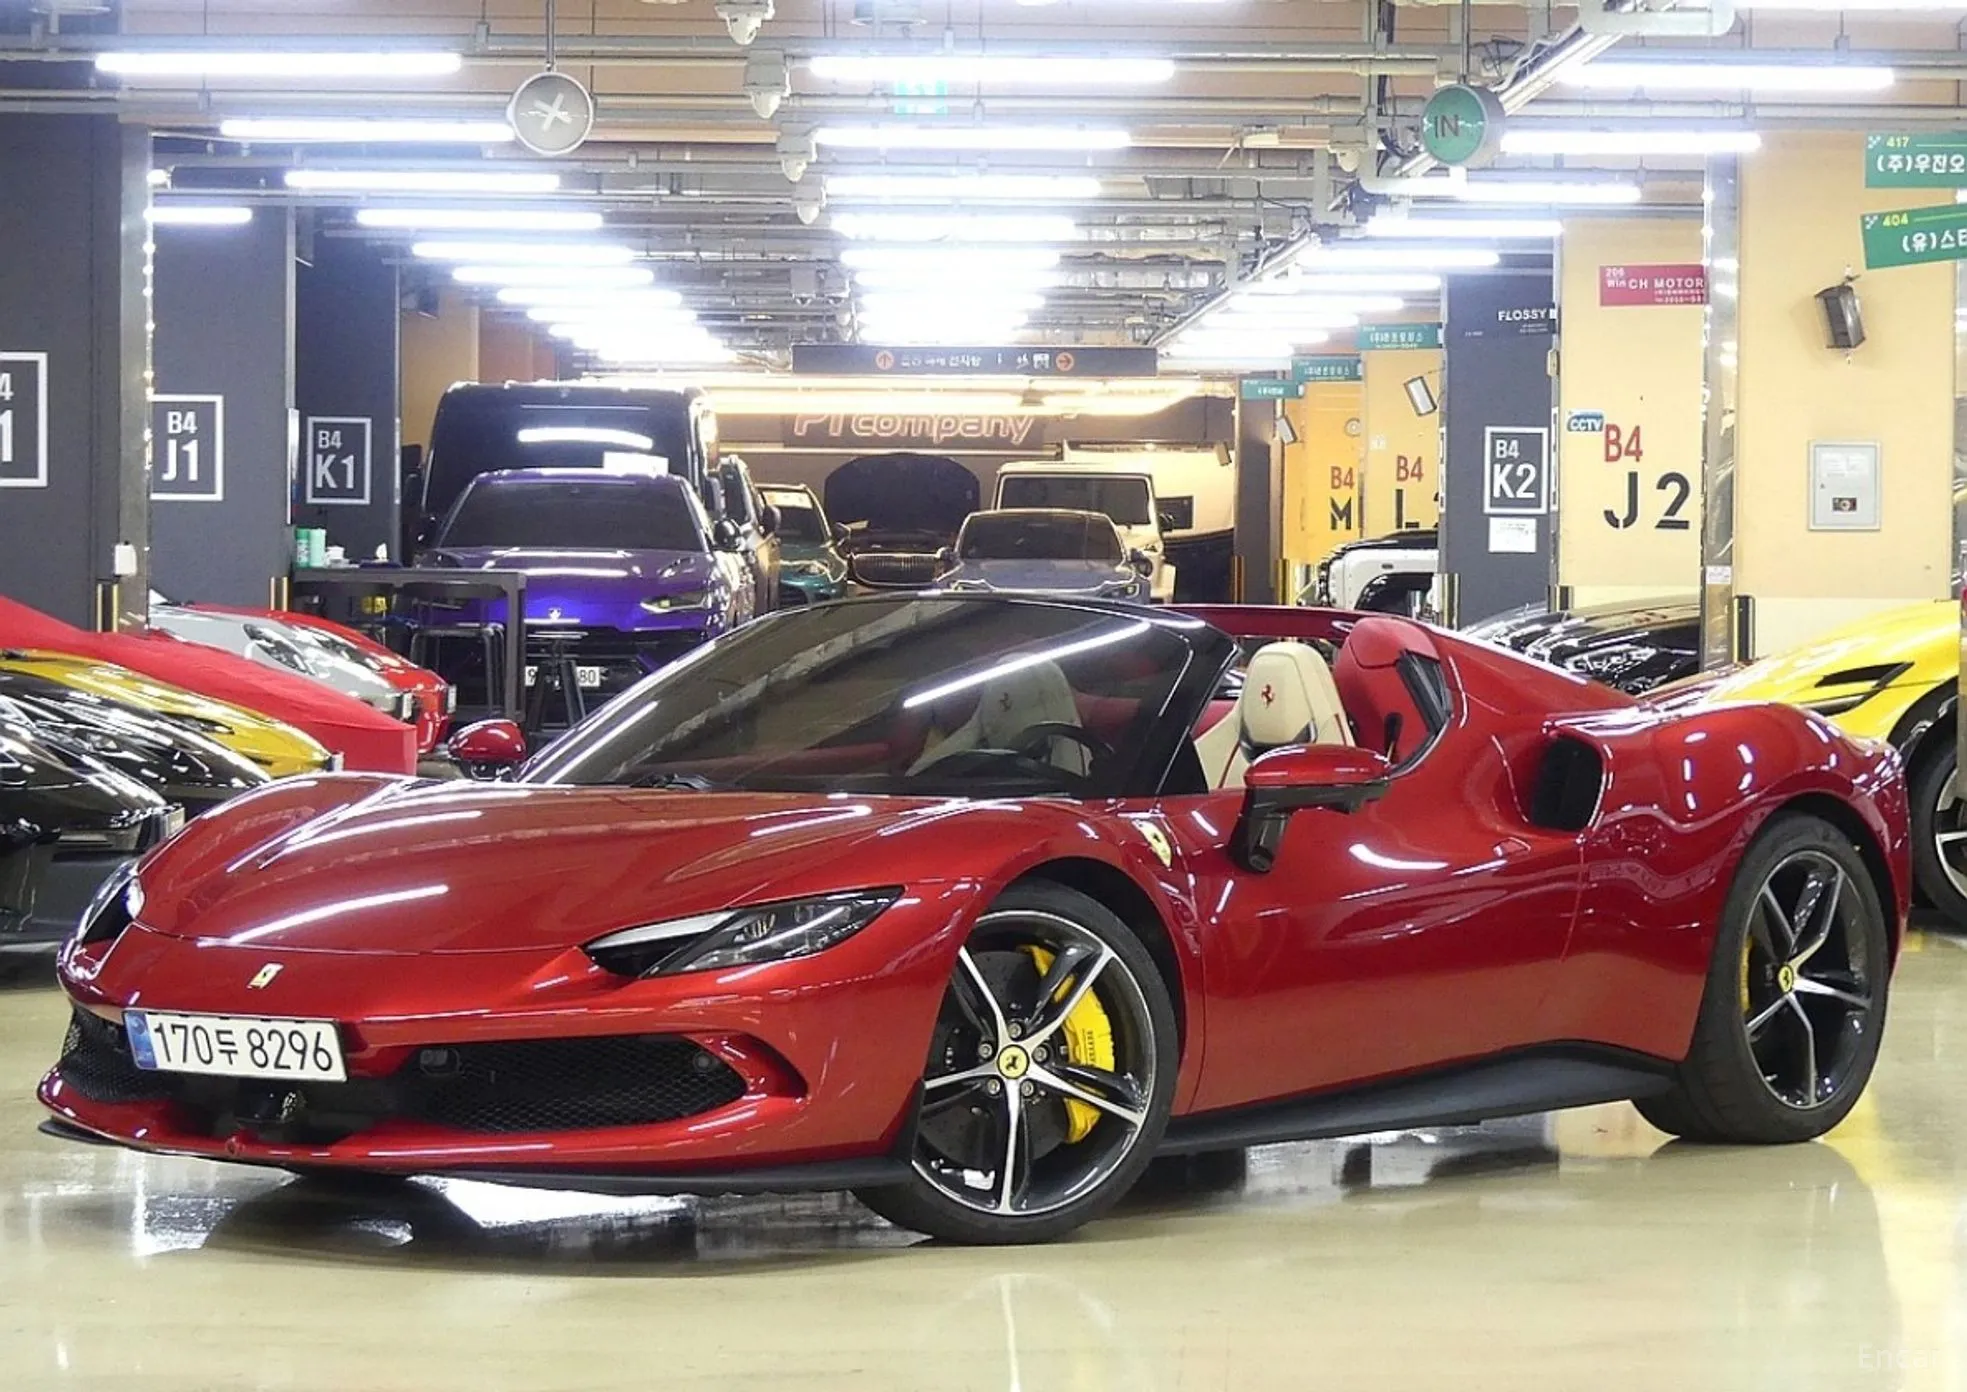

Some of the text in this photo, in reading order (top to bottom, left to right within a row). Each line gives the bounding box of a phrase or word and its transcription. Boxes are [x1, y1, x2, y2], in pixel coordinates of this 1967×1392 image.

[1434, 114, 1459, 139] IN
[1886, 136, 1910, 148] 417
[1882, 212, 1909, 227] 404
[1498, 308, 1547, 321] FLOSSY
[0, 373, 14, 400] 4
[167, 411, 198, 434] B4
[1570, 417, 1601, 431] CCTV
[0, 410, 13, 462] 1
[318, 430, 342, 449] B4
[1605, 424, 1643, 463] B4
[161, 439, 199, 482] J1
[1496, 440, 1519, 459] B4
[315, 454, 355, 489] K1
[1331, 466, 1355, 489] B4
[1396, 455, 1424, 482] B4
[1493, 463, 1536, 498] K2
[153, 1022, 333, 1072] 170두 8296
